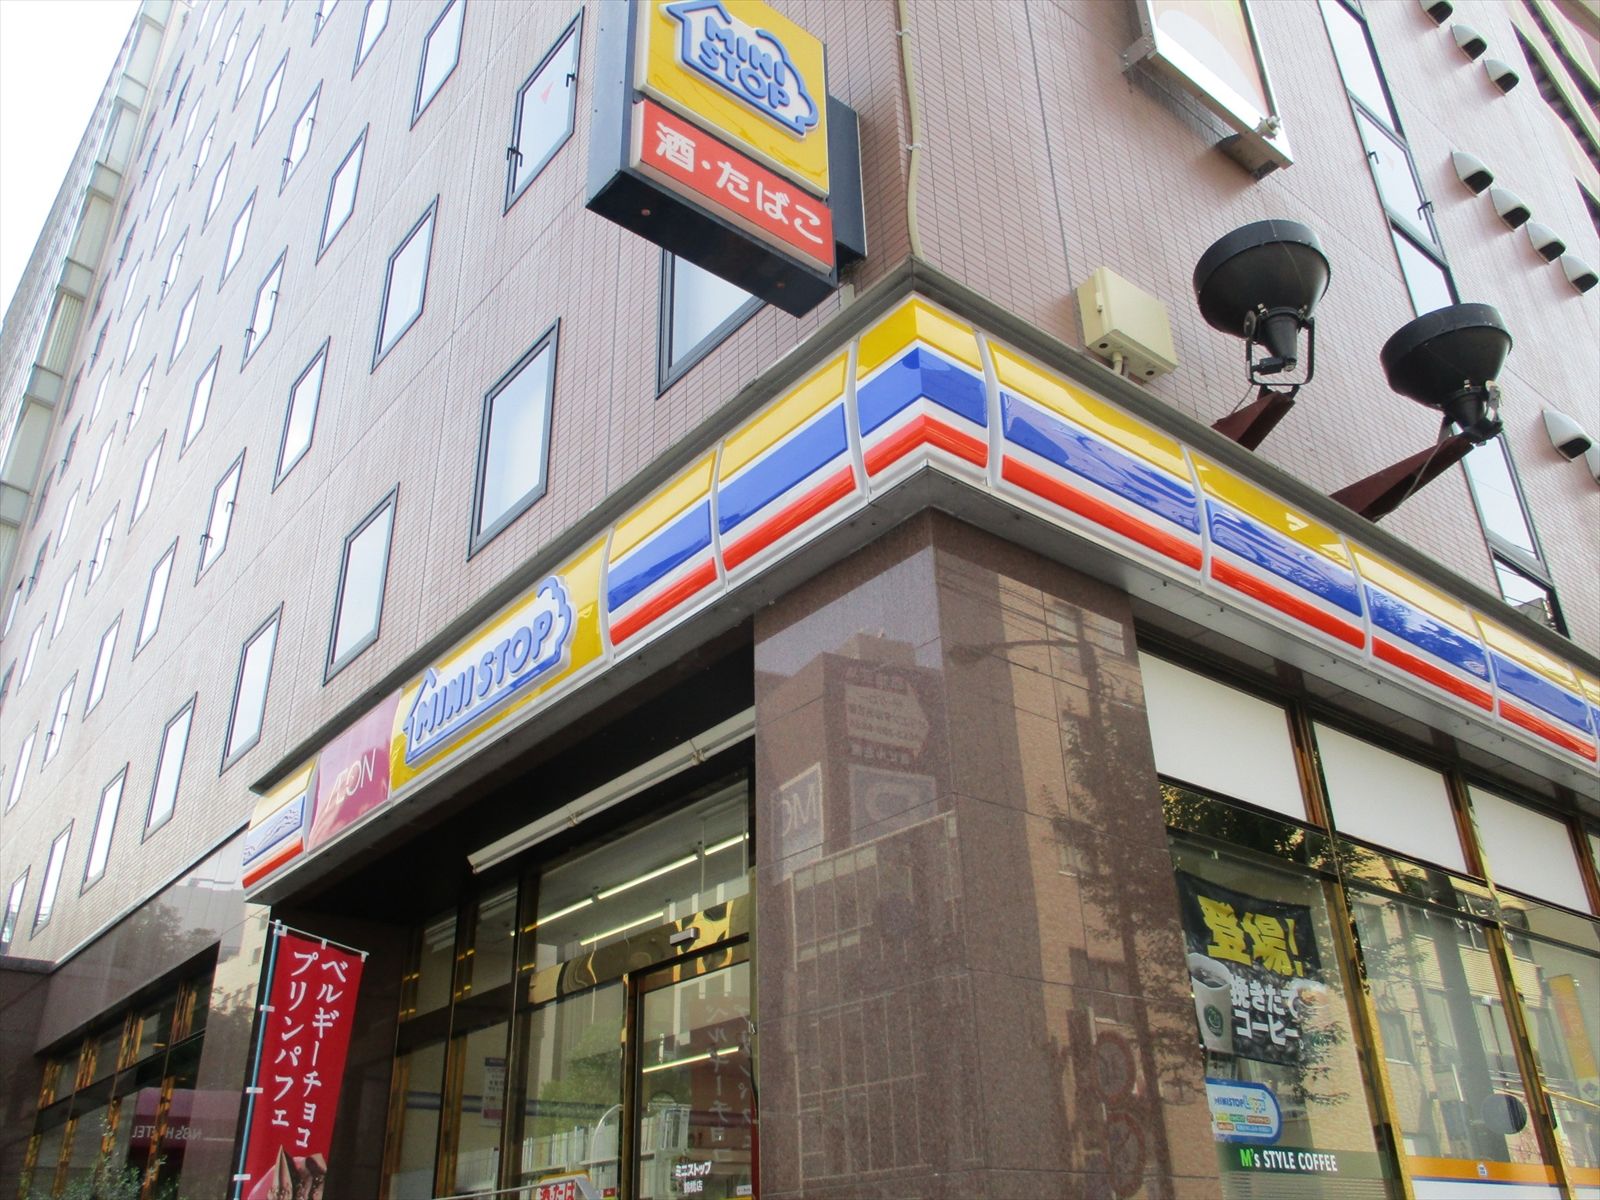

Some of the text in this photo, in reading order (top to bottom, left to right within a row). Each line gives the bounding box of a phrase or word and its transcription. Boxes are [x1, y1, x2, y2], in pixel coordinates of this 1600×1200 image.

[698, 40, 791, 109] STOP
[705, 14, 786, 86] MINI
[655, 121, 823, 244] 酒・たばこ
[415, 609, 553, 742] MINI STOP
[271, 951, 319, 1128] プリンパフェ
[296, 959, 349, 1149] ベルギーチョコ
[675, 1160, 712, 1177] ミニストップ
[1240, 1148, 1338, 1172] M's STYLE COFFEE
